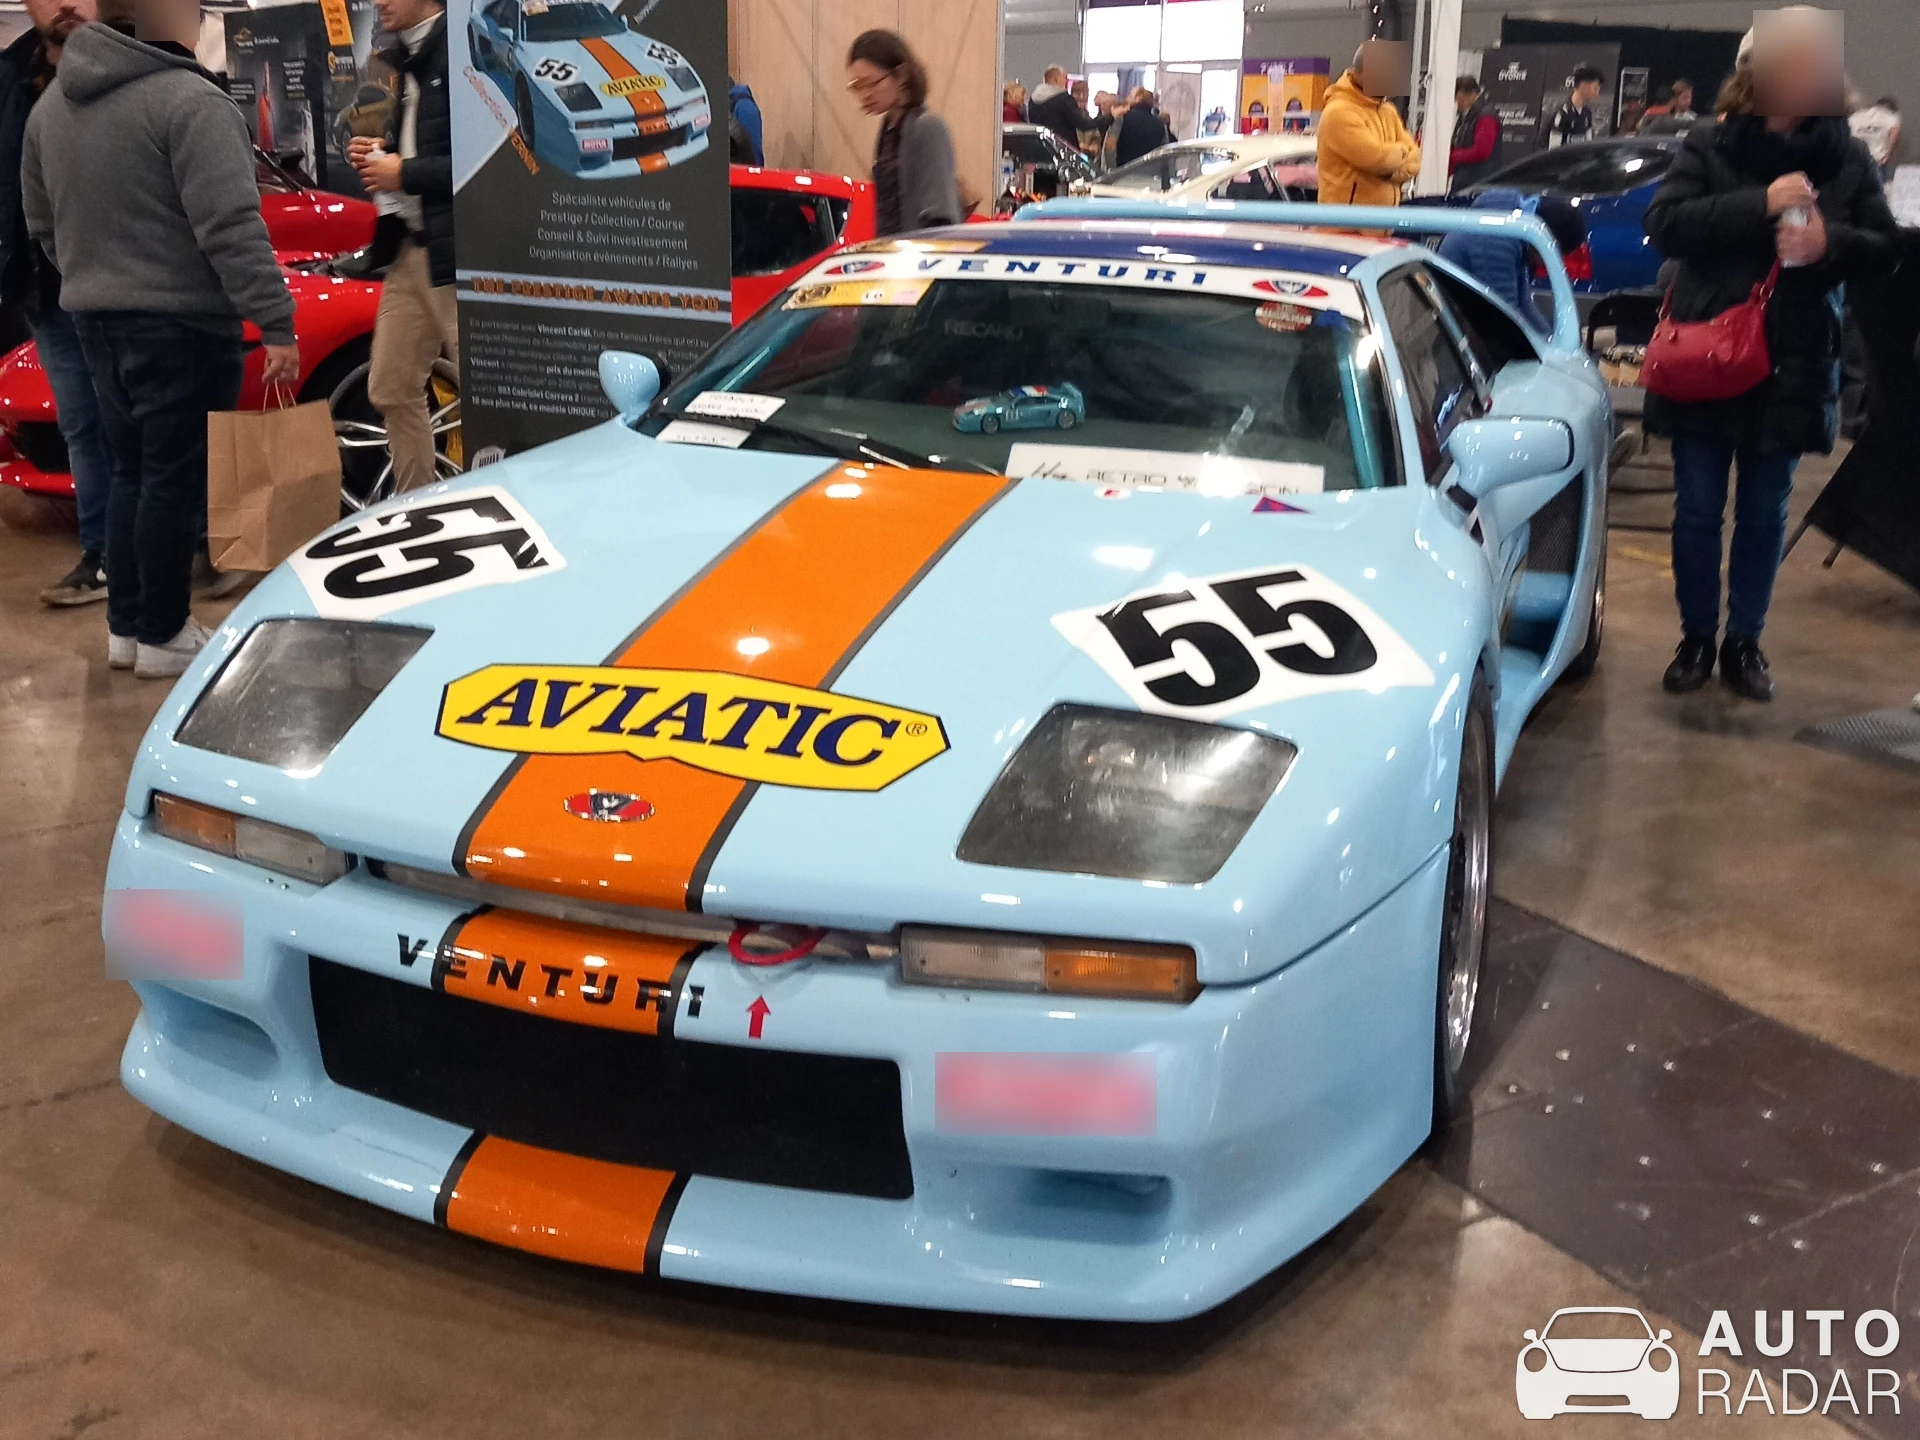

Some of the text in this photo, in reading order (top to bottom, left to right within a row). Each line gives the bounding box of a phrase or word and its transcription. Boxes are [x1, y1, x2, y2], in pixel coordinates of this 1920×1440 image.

[535, 58, 578, 81] 55
[552, 190, 672, 212] Spécialiste véhicules de
[540, 208, 583, 226] Prestige
[590, 211, 640, 229] Collection
[647, 215, 685, 231] Course
[537, 227, 688, 251] Conseil & Suivi investissement
[529, 245, 592, 262] Organisation
[662, 254, 698, 271] Rallyes
[917, 257, 1207, 286] VENTURI
[601, 286, 671, 308] AWAITS
[537, 323, 567, 335] Vincent
[470, 356, 499, 368] Vincent
[567, 405, 597, 418] UNIQUE
[306, 496, 549, 599] 55
[1096, 570, 1378, 706] 55
[456, 678, 898, 766] AVIATIC
[397, 933, 705, 1019] VENTURI
